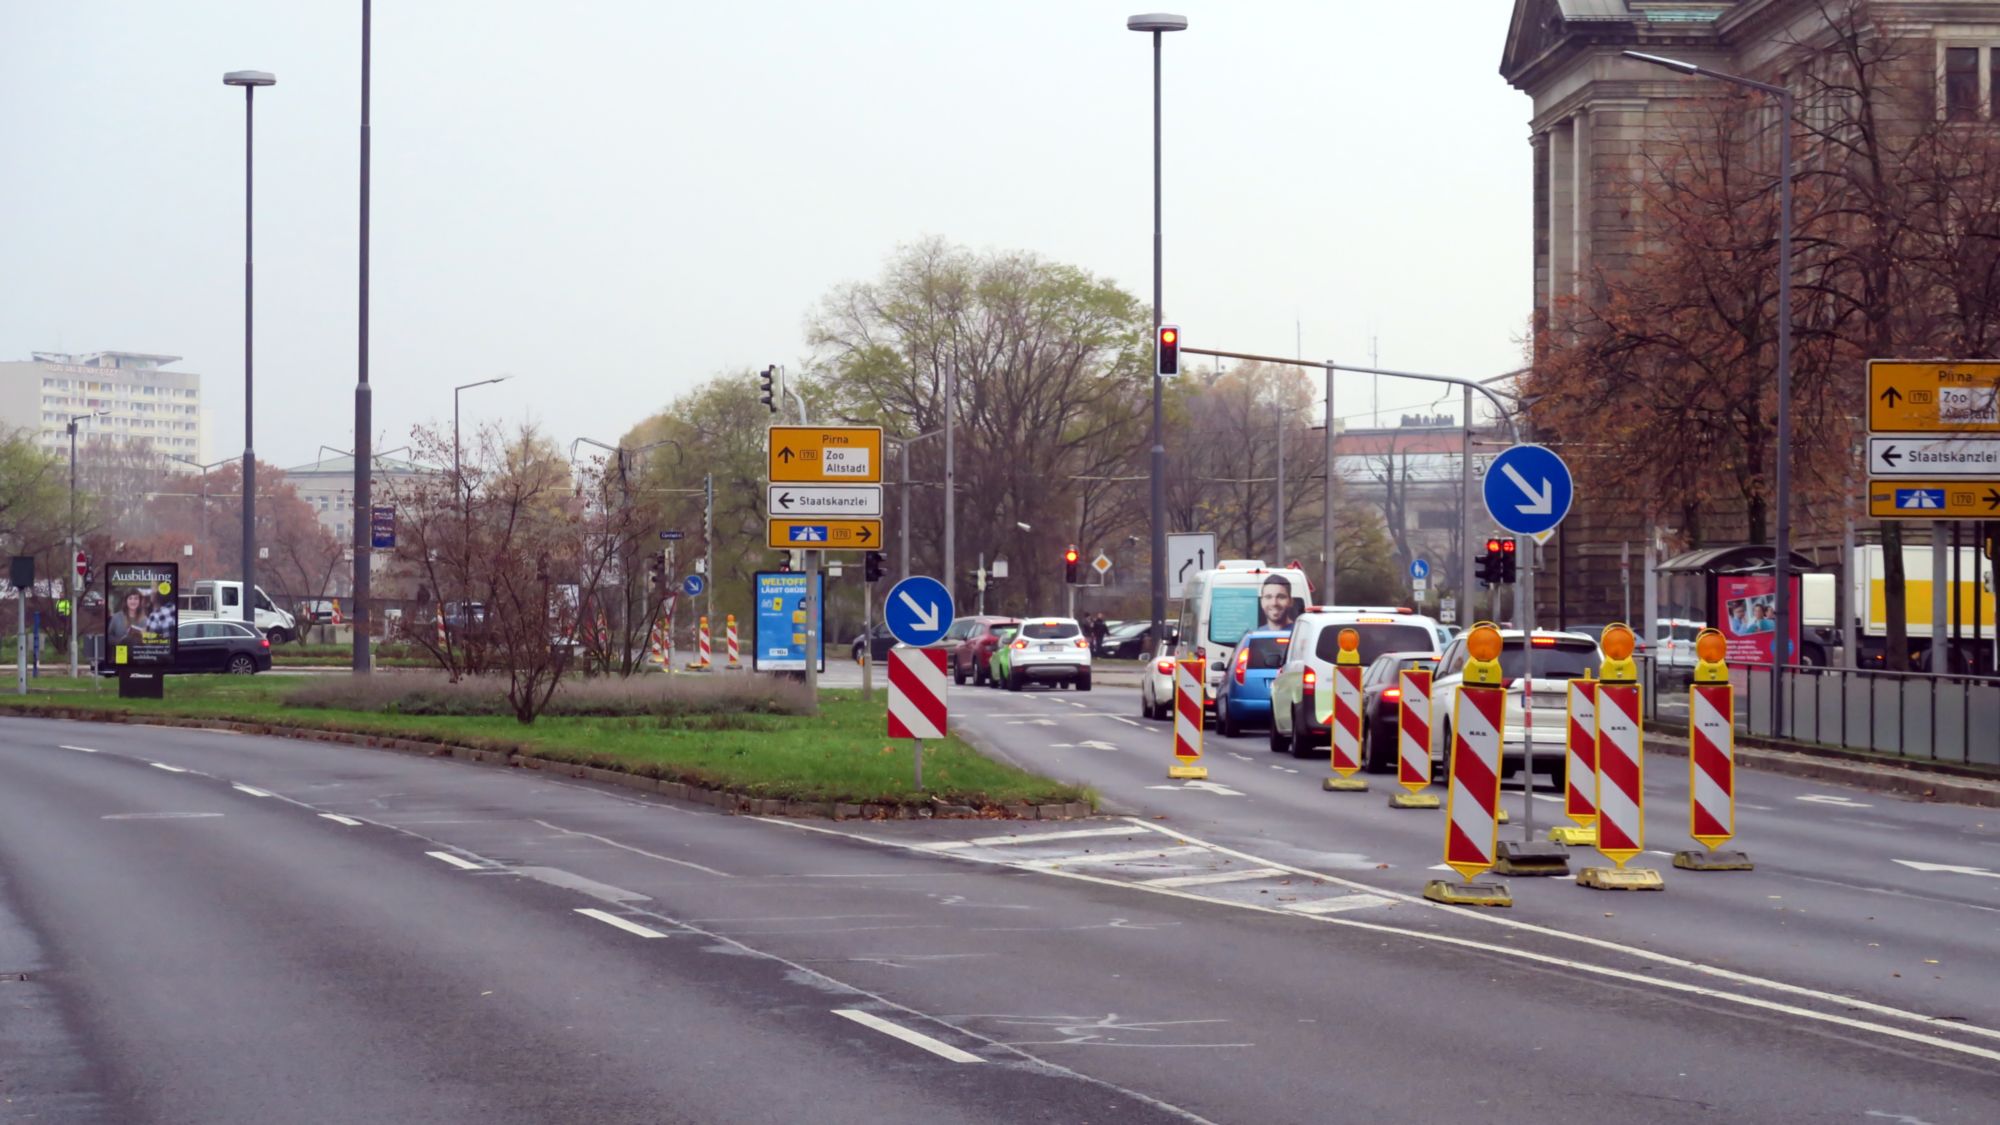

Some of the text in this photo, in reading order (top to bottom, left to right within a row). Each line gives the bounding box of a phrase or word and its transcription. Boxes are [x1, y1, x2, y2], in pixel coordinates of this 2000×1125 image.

[1943, 390, 1968, 403] Zoo
[822, 434, 849, 444] Pirna
[826, 450, 845, 460] Zoo
[1908, 450, 1998, 463] Staatskanzlei
[826, 464, 866, 473] Altstadt
[799, 496, 868, 506] Staatskanzlei
[112, 569, 172, 584] Ausbildung
